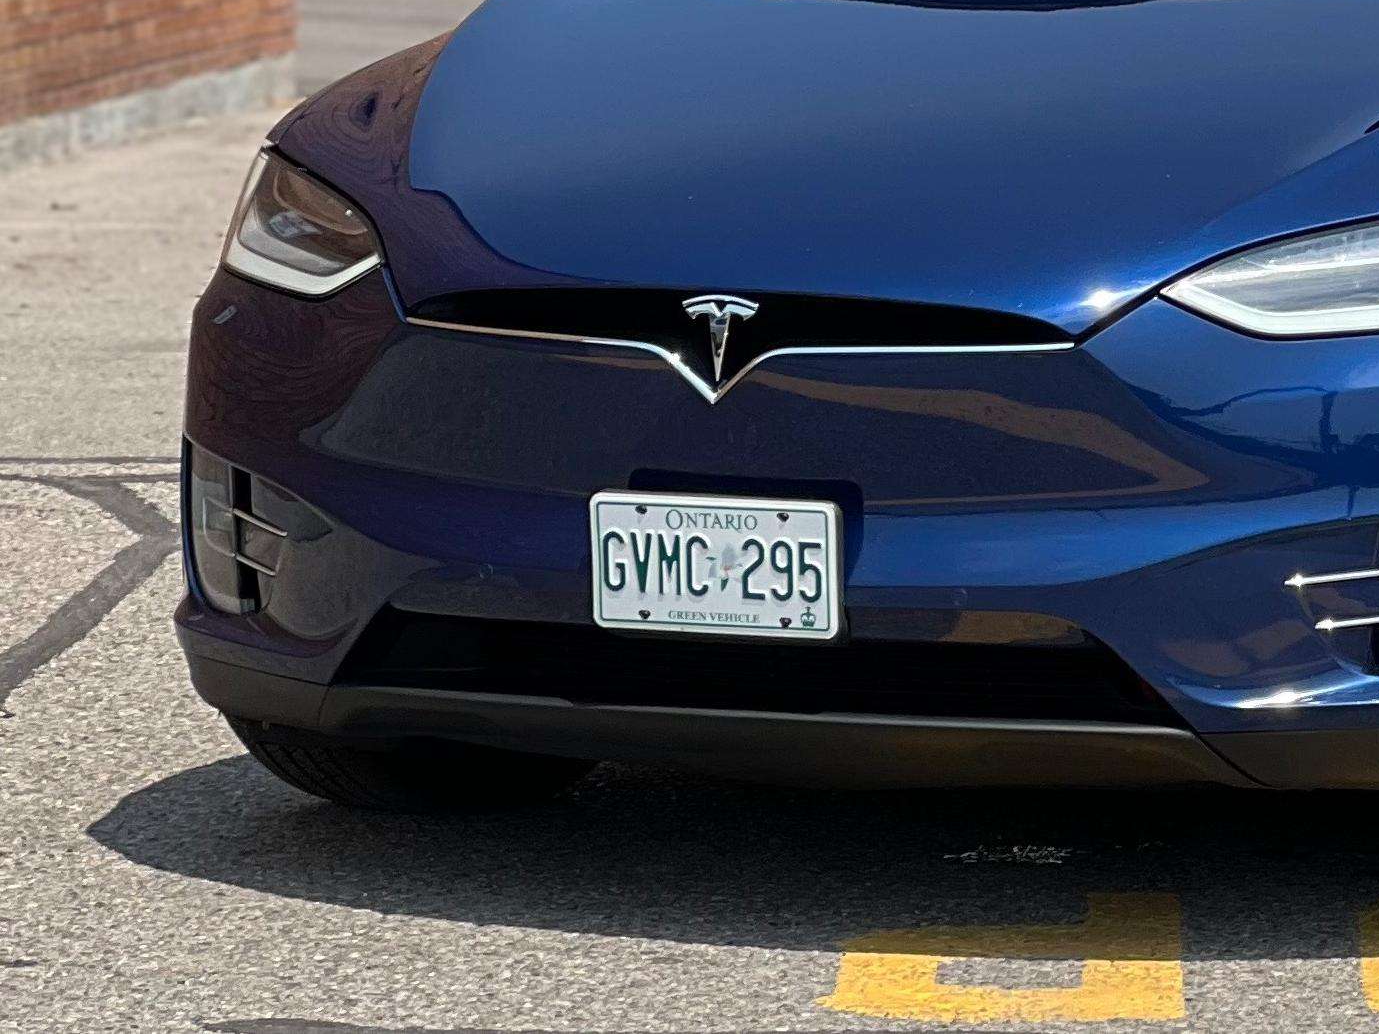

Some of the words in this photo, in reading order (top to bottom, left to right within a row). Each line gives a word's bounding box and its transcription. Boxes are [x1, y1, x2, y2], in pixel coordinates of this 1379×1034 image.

[665, 509, 758, 532] ONTARIO
[602, 530, 709, 597] GVMC
[741, 538, 822, 603] 295
[667, 609, 707, 622] GREEN
[709, 612, 760, 624] VEHICLE
